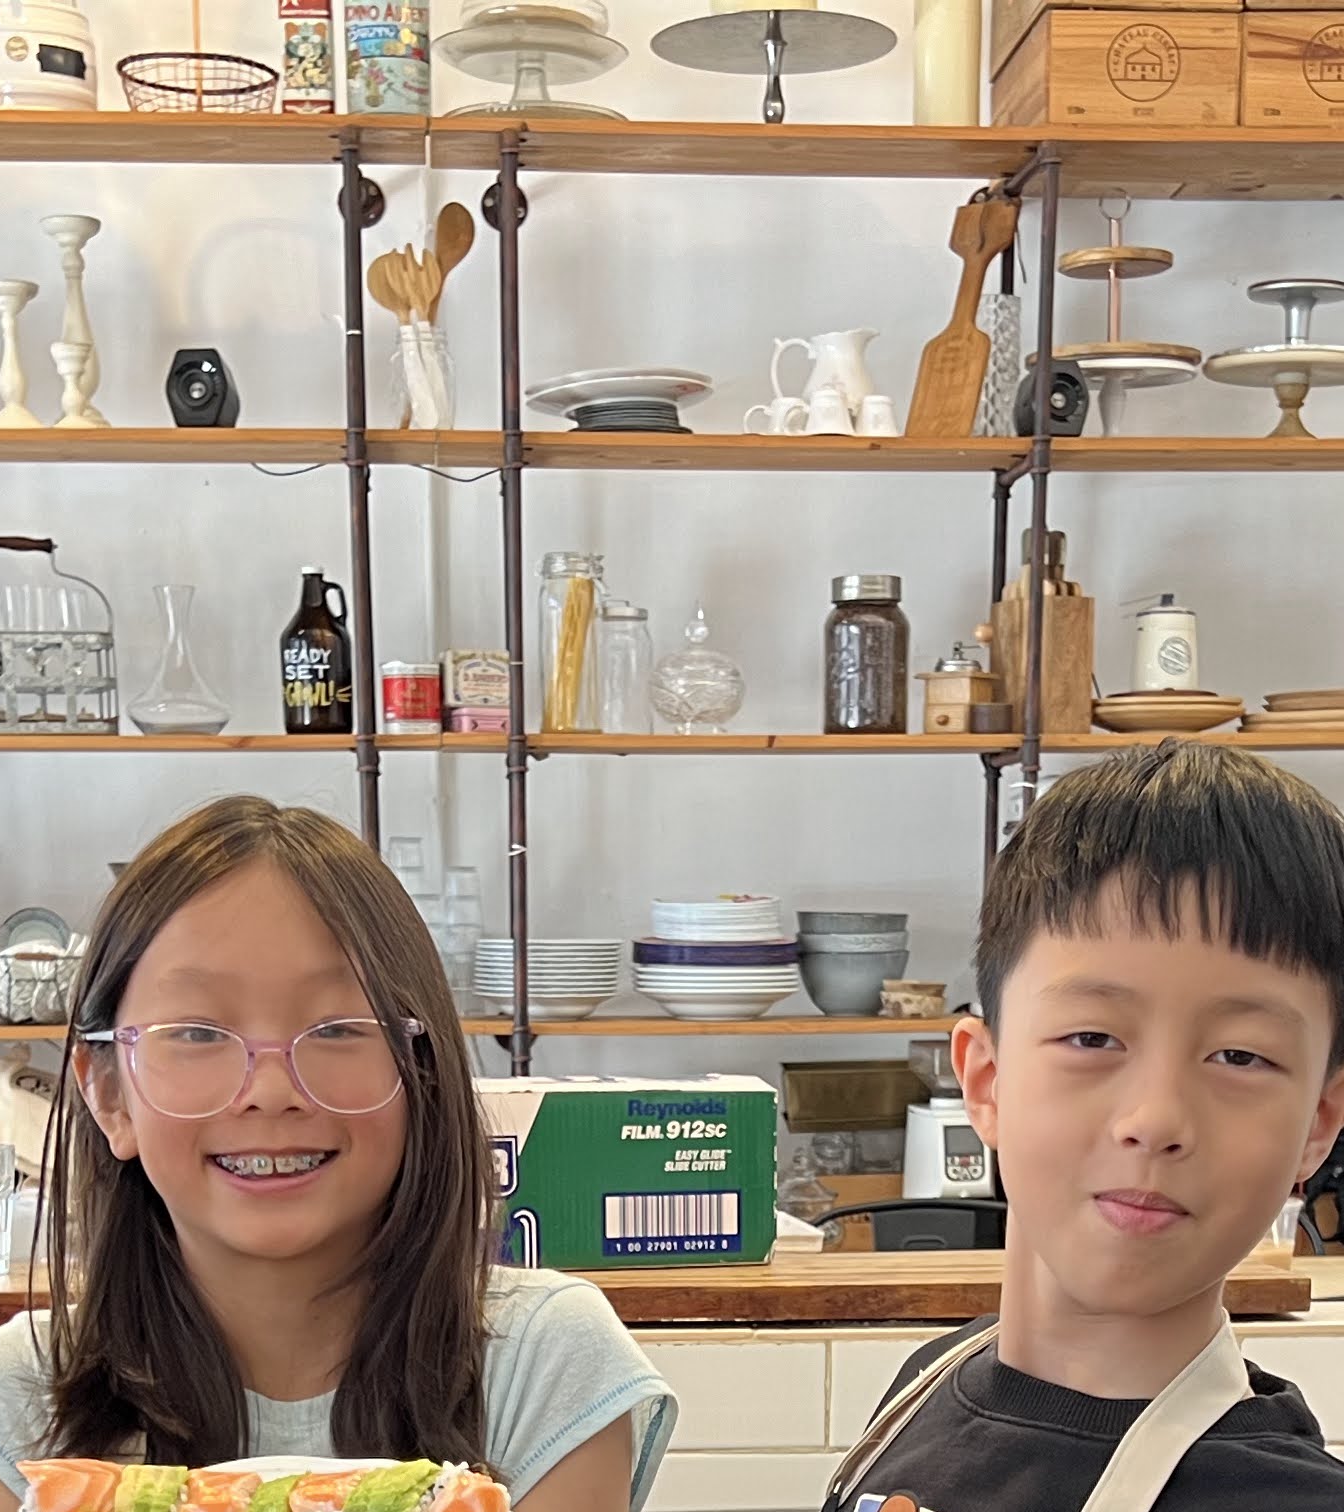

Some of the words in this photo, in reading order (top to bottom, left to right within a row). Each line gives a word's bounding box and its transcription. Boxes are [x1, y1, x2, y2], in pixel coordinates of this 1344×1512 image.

[284, 665, 331, 680] SET
[627, 1098, 727, 1120] Reynolds
[666, 1120, 727, 1140] 912SC
[675, 1150, 699, 1160] EASY
[664, 1161, 689, 1172] SLIDE
[691, 1160, 726, 1171] CUTTER
